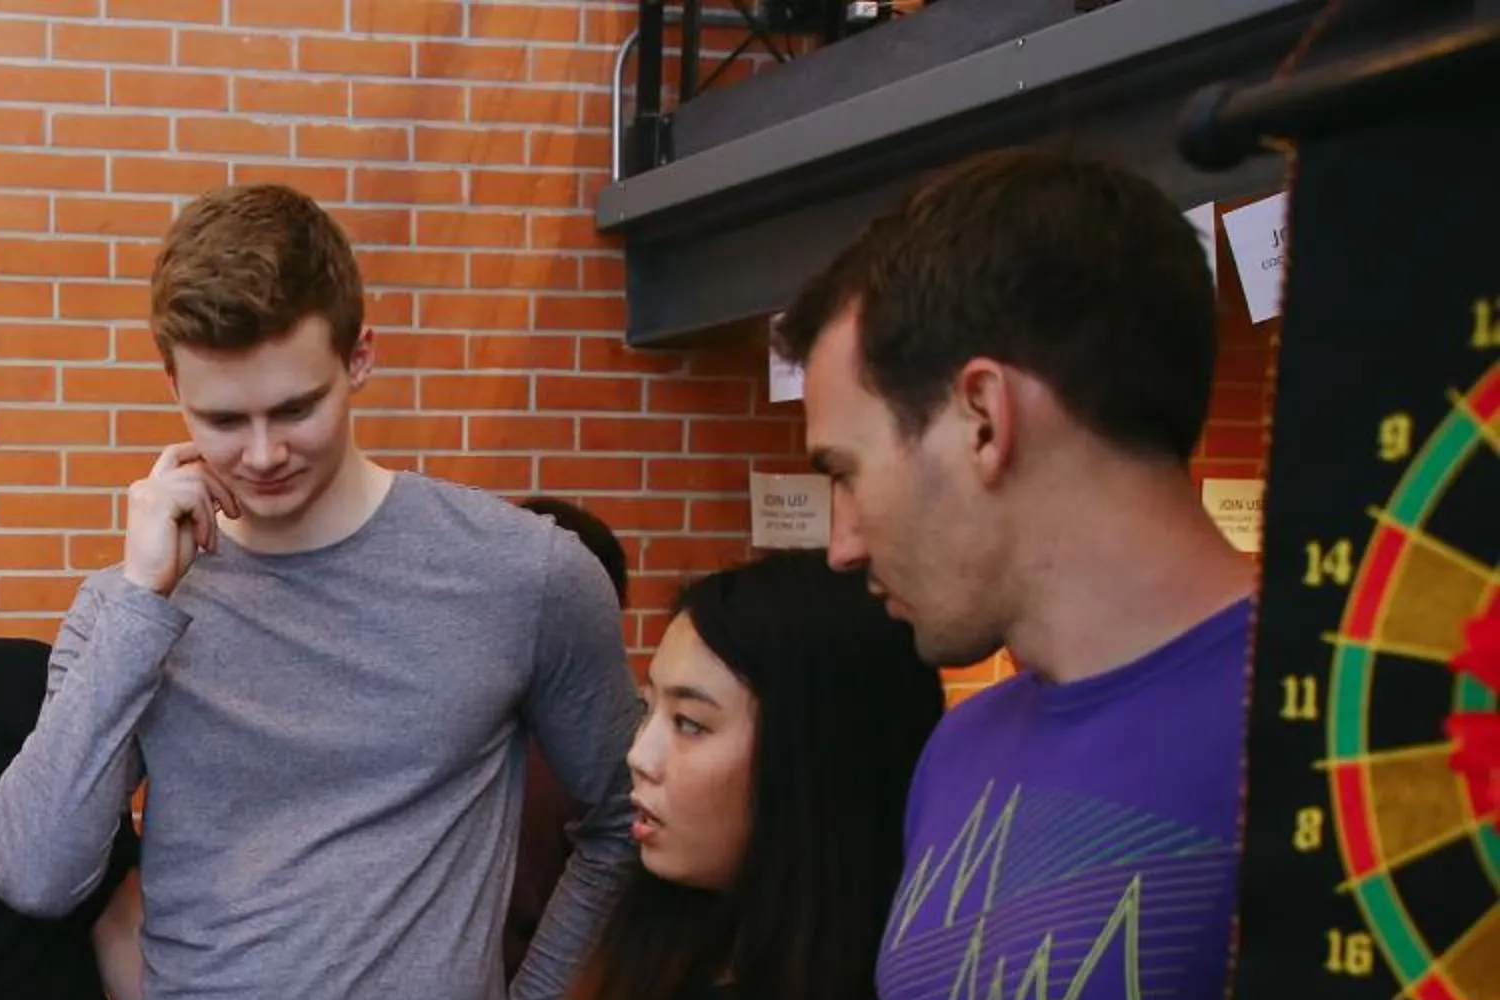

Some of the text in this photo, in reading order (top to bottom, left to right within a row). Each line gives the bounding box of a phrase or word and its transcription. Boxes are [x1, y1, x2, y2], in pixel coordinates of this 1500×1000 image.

[1380, 412, 1411, 461] 9
[1303, 537, 1351, 587] 14
[1280, 674, 1318, 720] 11
[1294, 806, 1324, 851] 8
[1325, 928, 1373, 976] 16
